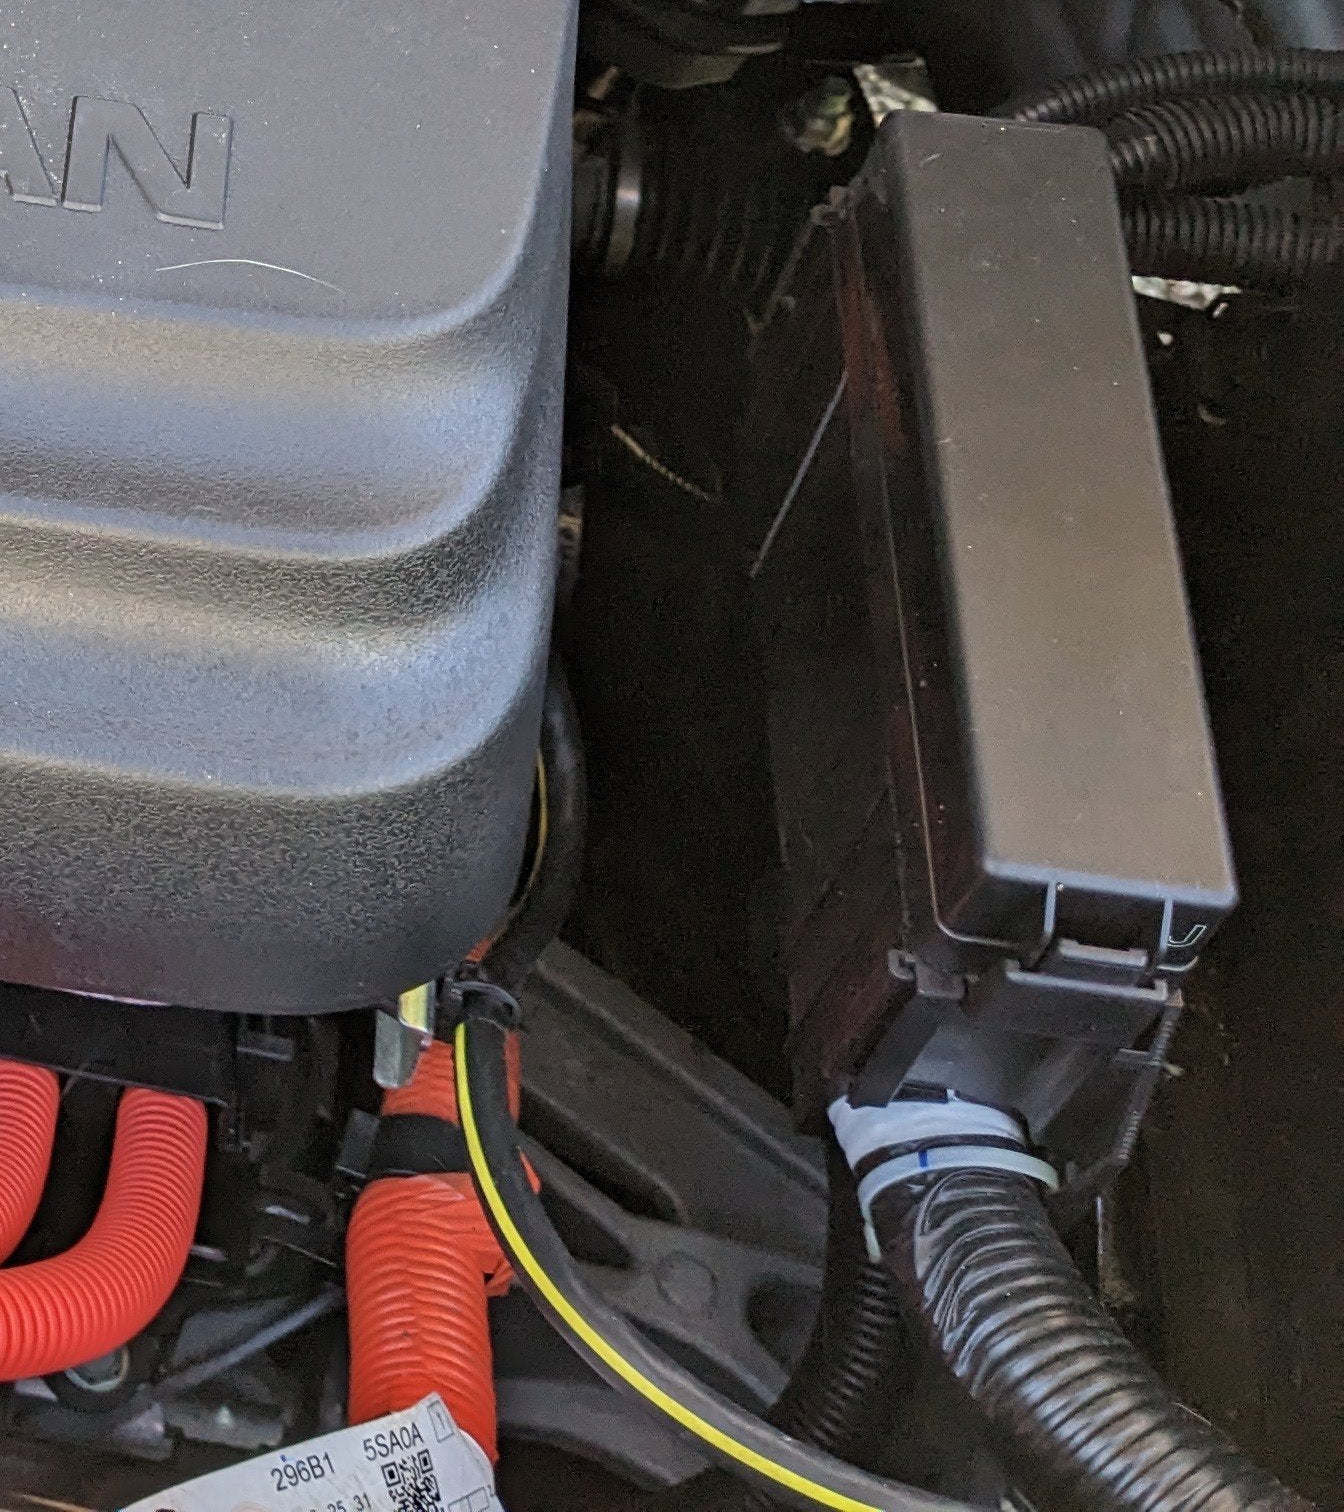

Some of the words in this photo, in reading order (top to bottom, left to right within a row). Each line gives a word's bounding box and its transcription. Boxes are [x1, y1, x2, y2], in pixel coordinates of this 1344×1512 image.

[270, 1451, 336, 1492] 296B1
[362, 1421, 425, 1462] 5SA0A
[353, 1491, 372, 1510] 31
